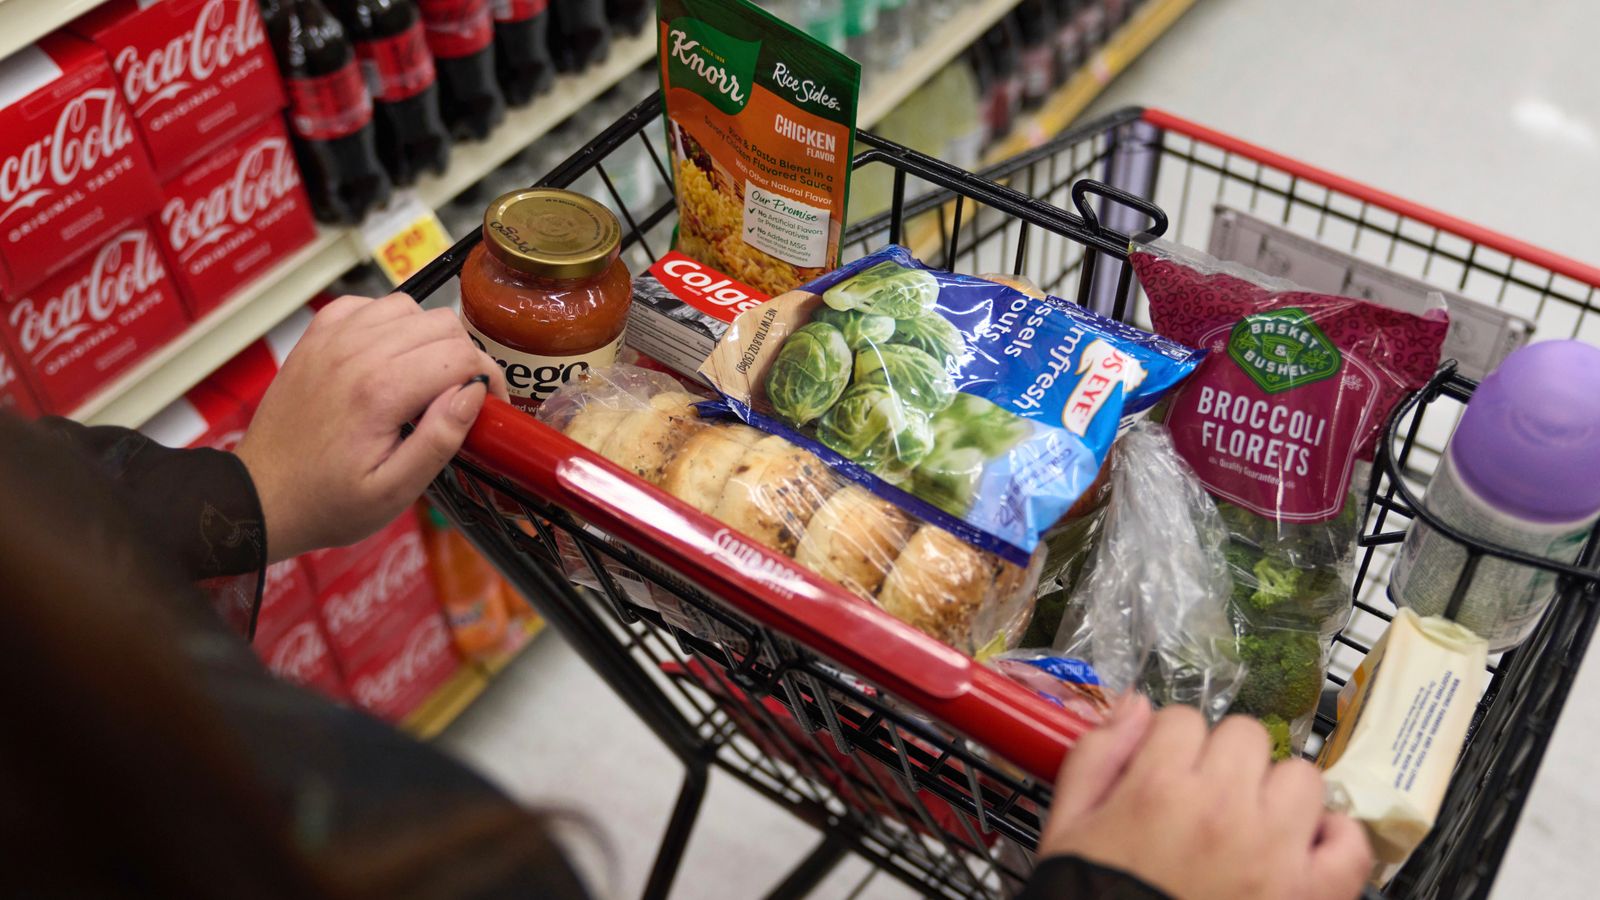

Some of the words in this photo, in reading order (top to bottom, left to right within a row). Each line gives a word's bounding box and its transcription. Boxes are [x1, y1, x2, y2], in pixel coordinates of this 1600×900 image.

[670, 29, 744, 102] Knorr
[772, 62, 799, 91] Rice
[795, 80, 837, 110] Sides
[774, 114, 836, 153] CHICKEN
[751, 144, 777, 165] Pasta
[779, 156, 811, 176] Blend
[813, 166, 824, 179] in
[826, 174, 834, 183] a
[806, 147, 835, 164] FLAVOR
[735, 157, 749, 174] With
[748, 168, 769, 187] Other
[771, 180, 803, 198] Natural
[804, 189, 833, 206] Flavor
[752, 157, 797, 182] Flavored
[799, 176, 833, 193] Sauce
[750, 189, 771, 206] Our
[772, 198, 819, 223] Promise
[757, 209, 768, 220] No
[768, 213, 795, 230] Artificial
[796, 223, 824, 236] Flavors
[490, 221, 539, 254] Prego
[757, 226, 768, 237] No
[789, 238, 808, 251] MSG
[764, 219, 810, 242] Preservatives
[663, 259, 763, 314] Colga
[758, 320, 772, 332] WT
[763, 308, 778, 321] NET
[752, 331, 767, 346] 10.8
[1251, 322, 1318, 349] BASKET
[1274, 344, 1286, 357] &
[1012, 324, 1085, 411] mfresh
[1243, 350, 1308, 377] BUSHEL
[1072, 374, 1110, 418] EYE
[1197, 386, 1327, 447] BROCCOLI
[1202, 421, 1311, 476] FLORETS
[1219, 458, 1243, 475] Quality
